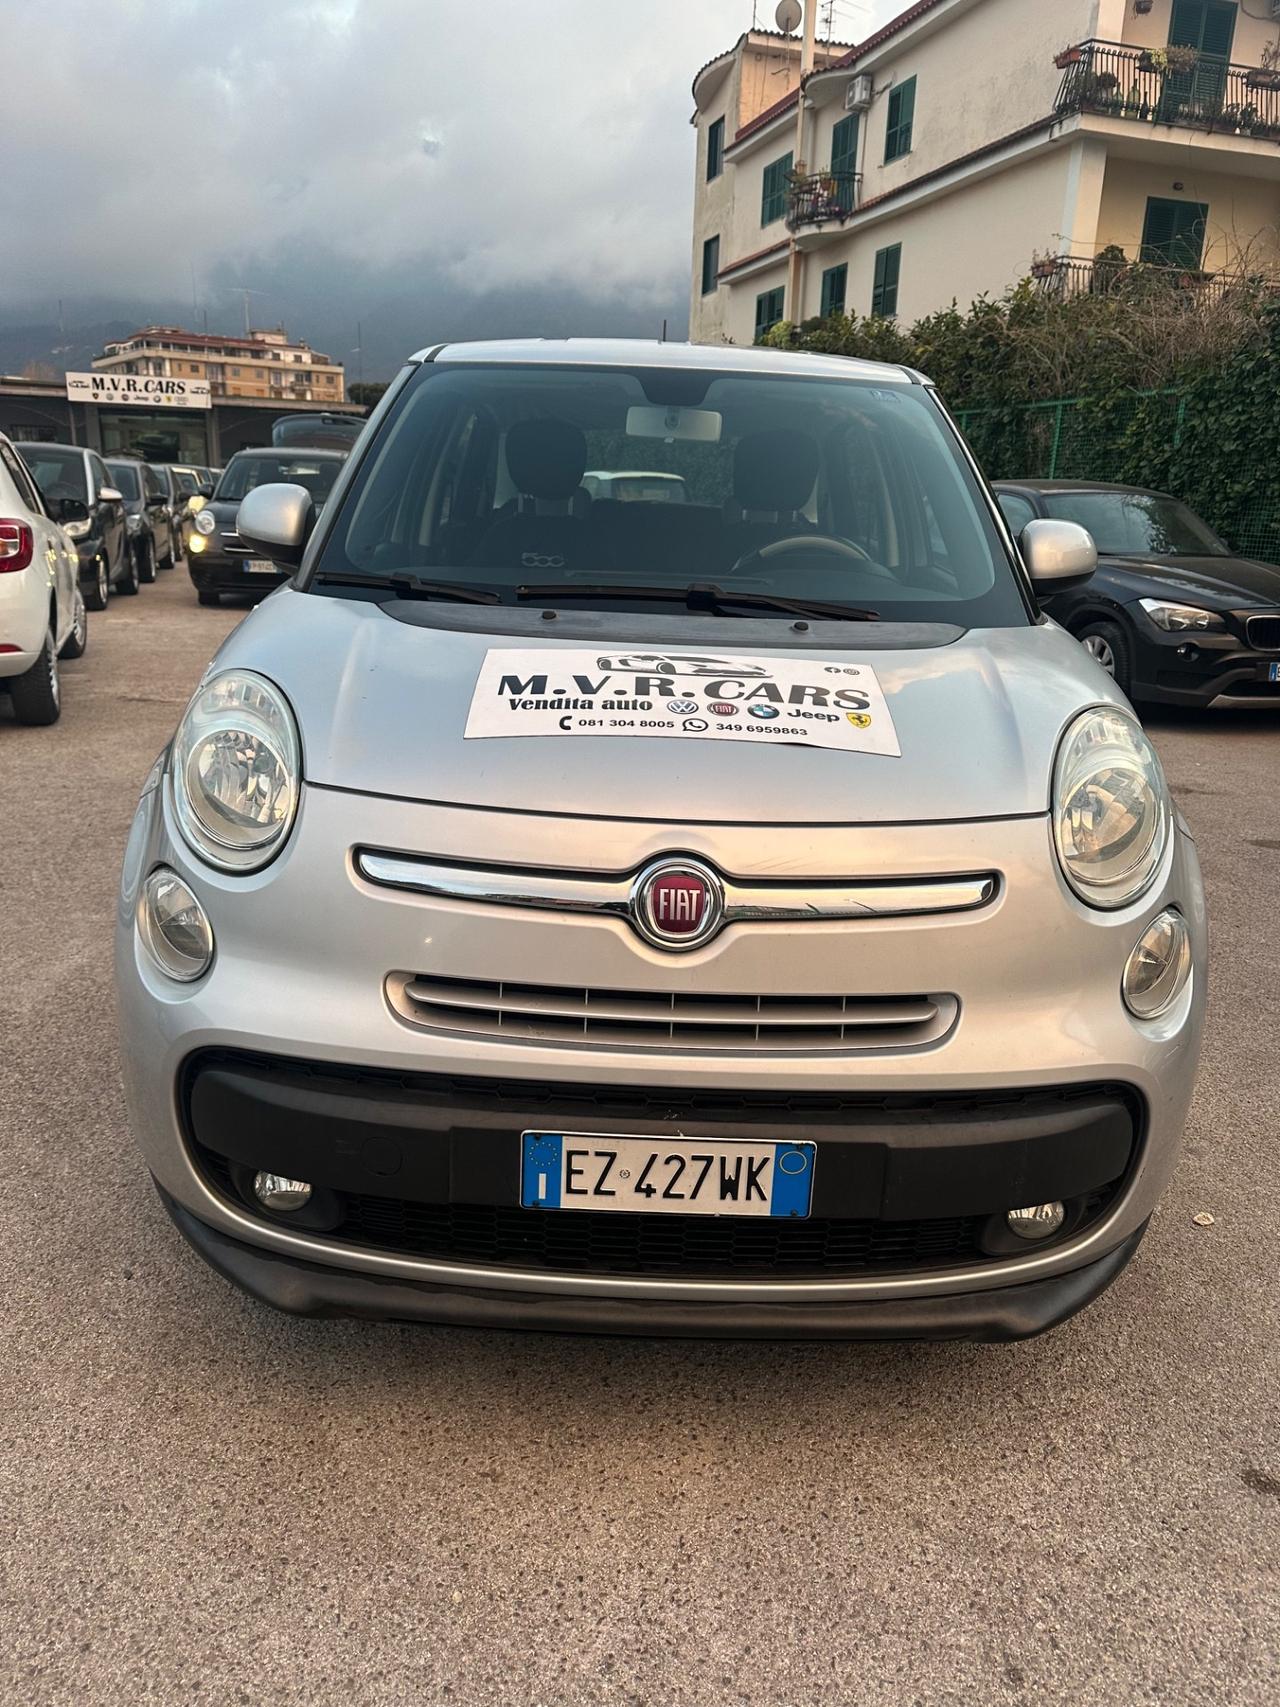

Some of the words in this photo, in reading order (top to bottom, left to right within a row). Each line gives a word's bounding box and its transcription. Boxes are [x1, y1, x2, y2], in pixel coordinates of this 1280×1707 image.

[509, 697, 593, 711] Vendita
[602, 698, 653, 711] auto
[787, 709, 841, 722] Jeep
[578, 719, 604, 727] 081
[609, 719, 635, 727] 304
[640, 719, 675, 728] 8005
[716, 723, 743, 731] 349
[747, 724, 808, 736] 6959863
[659, 888, 701, 921] FIAT
[565, 1150, 618, 1196] EZ
[634, 1153, 770, 1201] 427WK
